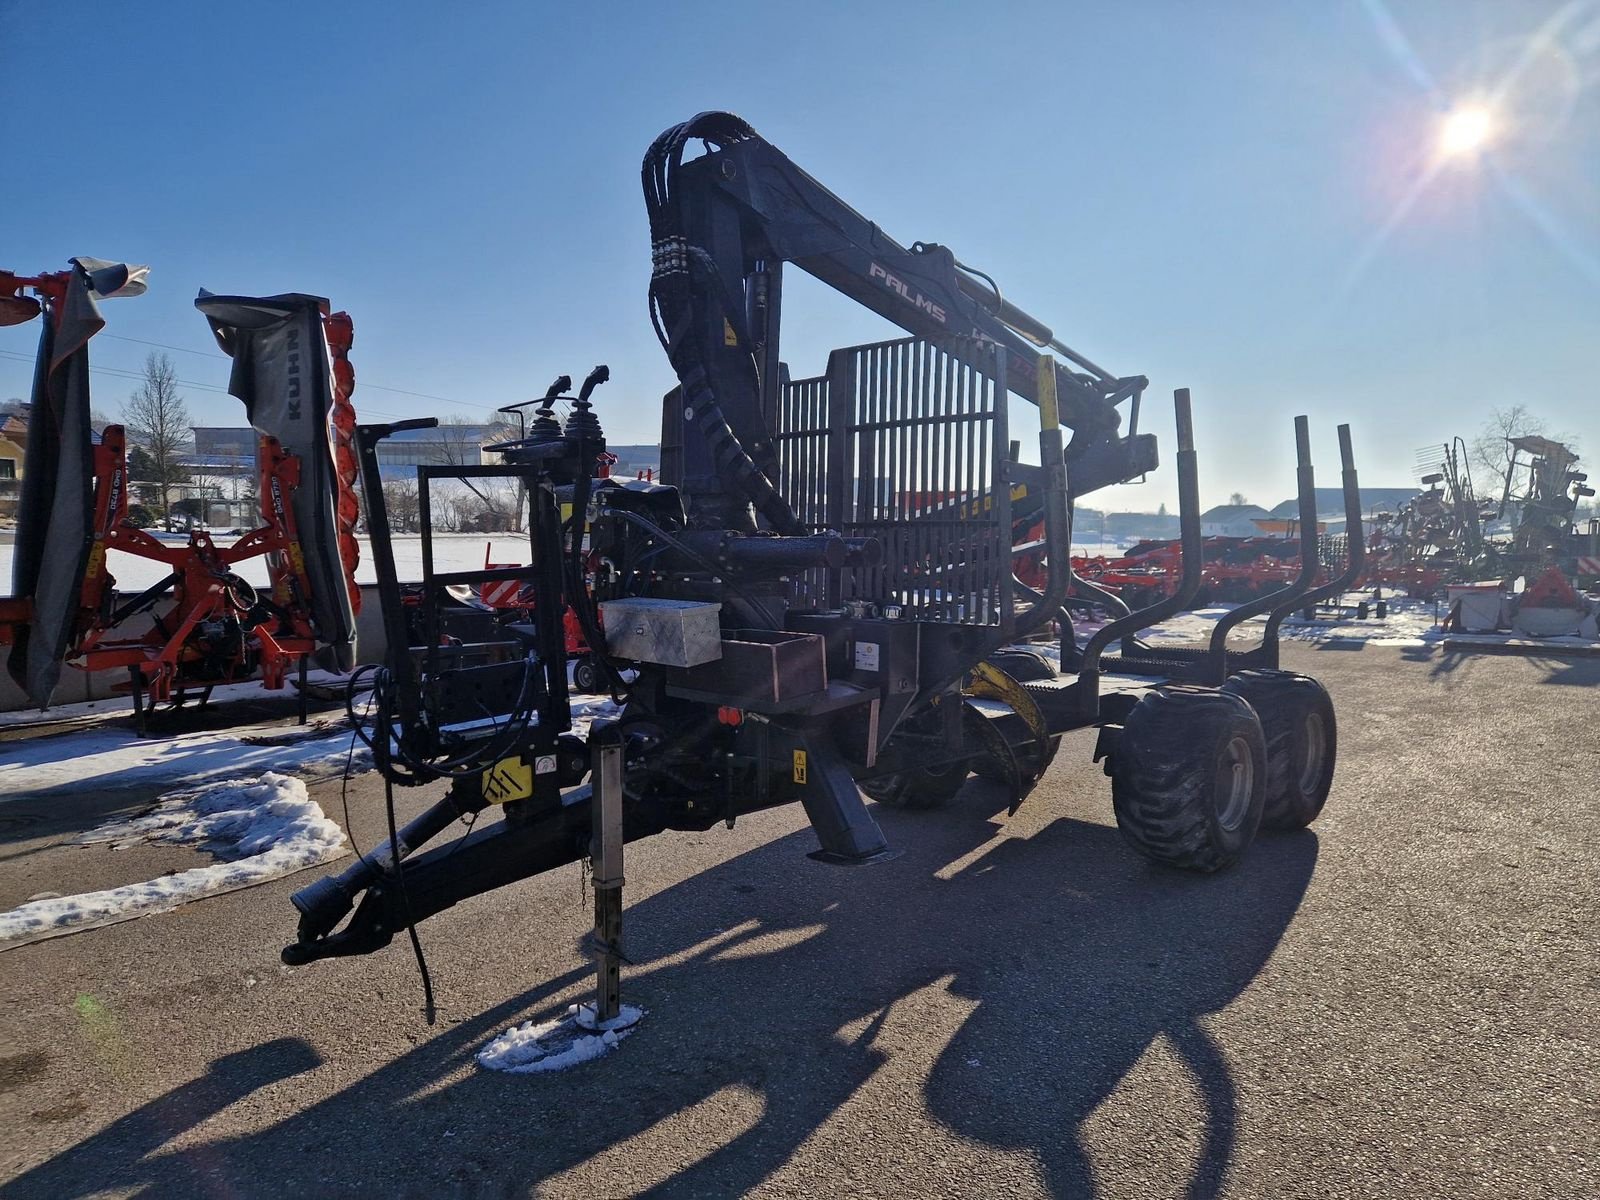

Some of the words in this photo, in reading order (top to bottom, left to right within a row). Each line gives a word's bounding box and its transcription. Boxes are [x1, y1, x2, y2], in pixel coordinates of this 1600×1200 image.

[869, 262, 946, 323] PALMS
[287, 330, 300, 420] KUHN
[113, 469, 121, 487] GMD
[275, 497, 283, 514] GMD
